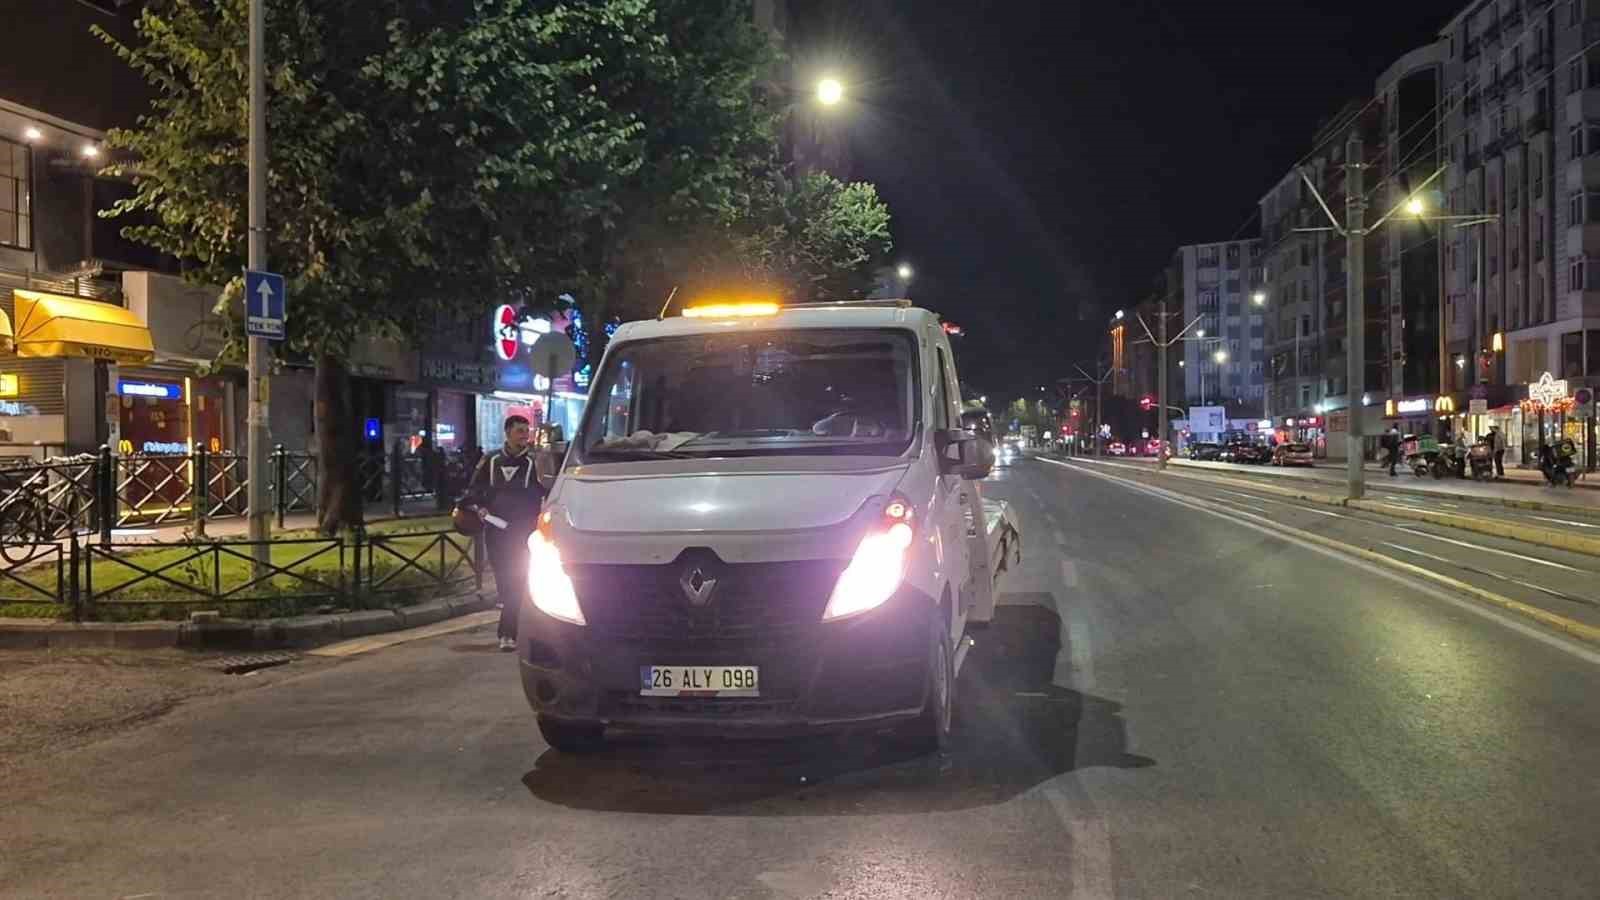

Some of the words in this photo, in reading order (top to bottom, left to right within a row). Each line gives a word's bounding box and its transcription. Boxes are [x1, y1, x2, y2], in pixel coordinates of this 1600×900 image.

[653, 669, 672, 688] 26
[682, 669, 713, 688] ALY
[722, 669, 755, 688] 098
